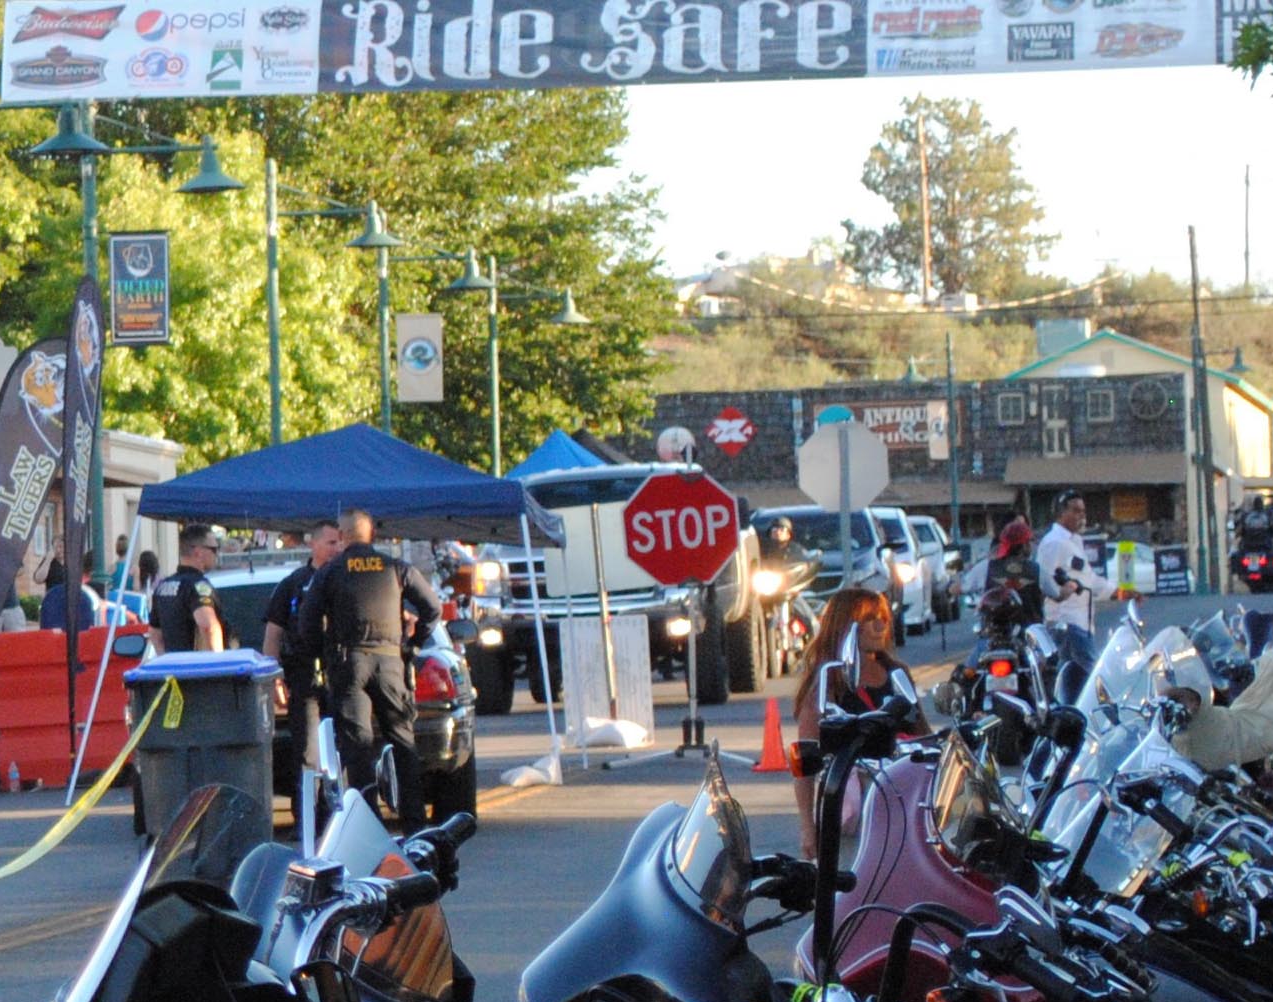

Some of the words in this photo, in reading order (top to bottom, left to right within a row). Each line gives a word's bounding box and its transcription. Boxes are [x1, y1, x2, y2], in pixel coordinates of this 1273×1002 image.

[169, 8, 246, 34] pepsi
[1011, 23, 1072, 41] YAVAPAI
[335, 0, 551, 88] Ride
[580, 0, 854, 81] Safe
[863, 406, 928, 428] ANTIQU
[1, 453, 56, 541] TIGERS
[631, 504, 731, 554] STOP
[346, 557, 385, 573] POLICE
